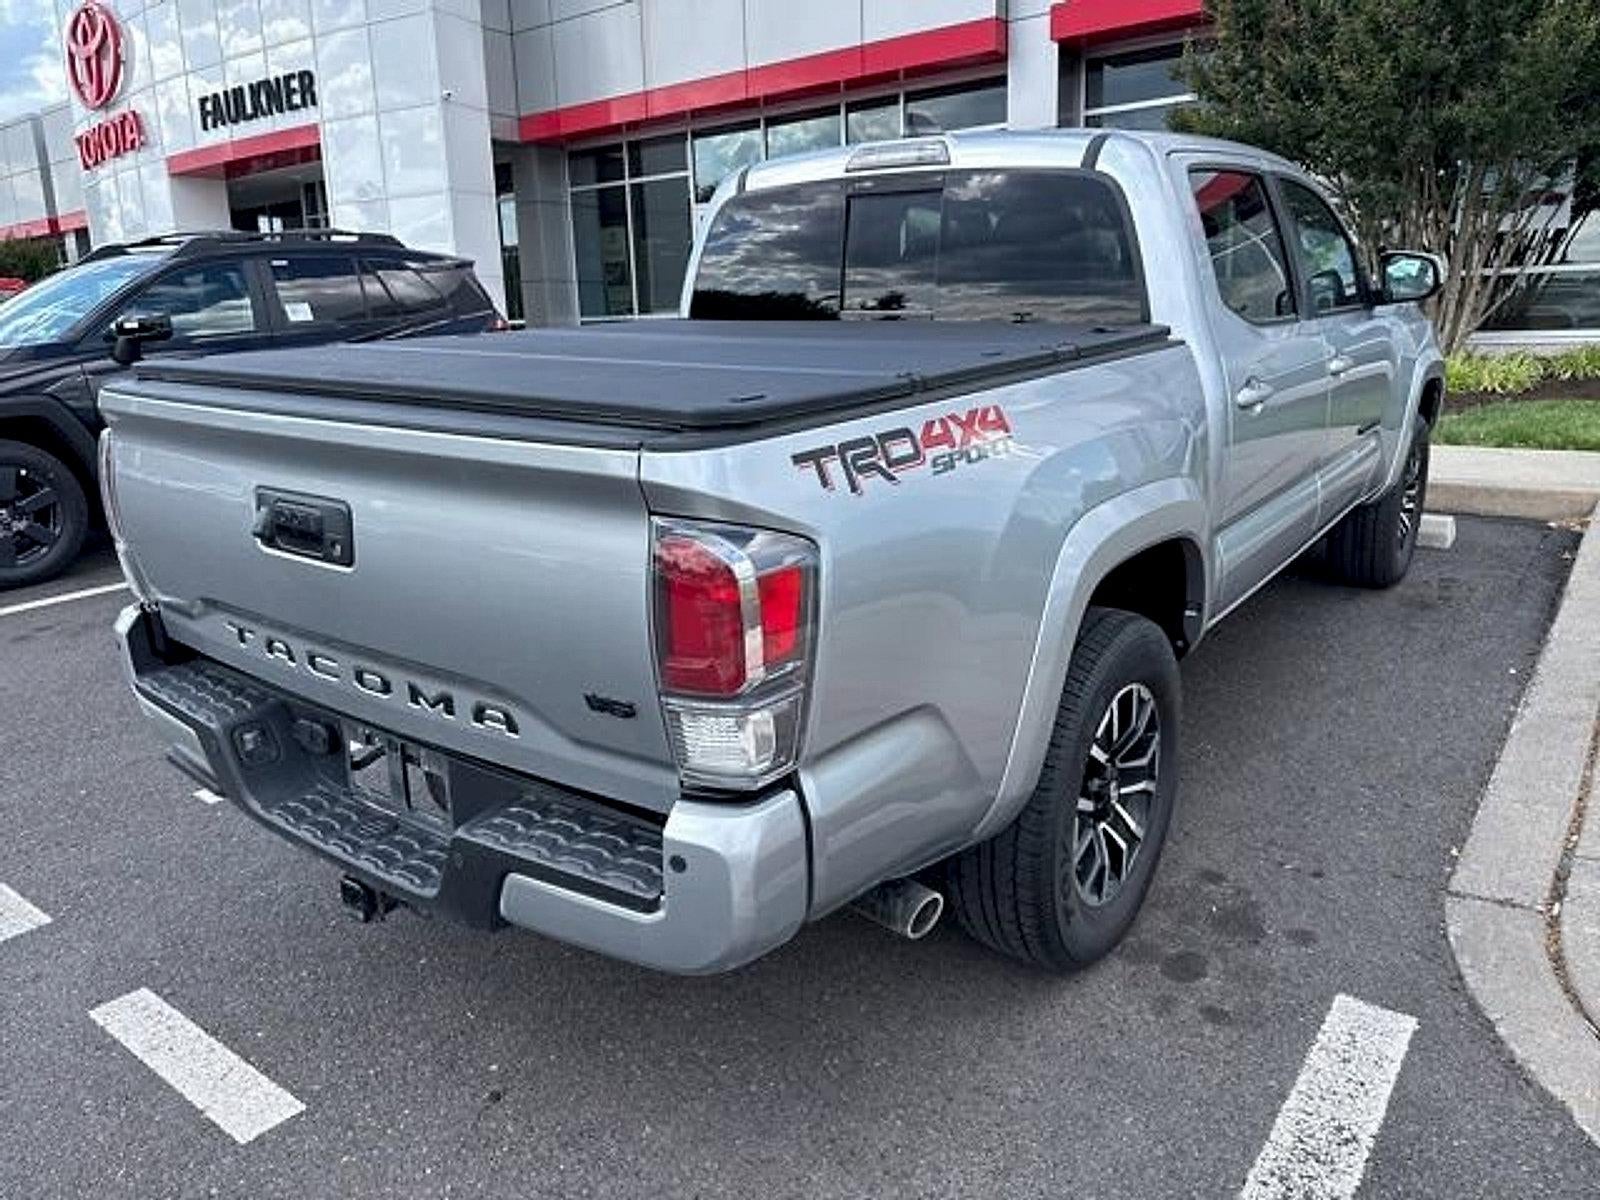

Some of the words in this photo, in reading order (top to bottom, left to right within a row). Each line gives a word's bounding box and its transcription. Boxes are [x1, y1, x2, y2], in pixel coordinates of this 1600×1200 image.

[198, 69, 318, 131] FAULKNER
[74, 110, 146, 171] TOYOTA
[790, 427, 926, 497] TRD
[223, 620, 521, 739] TACOMA
